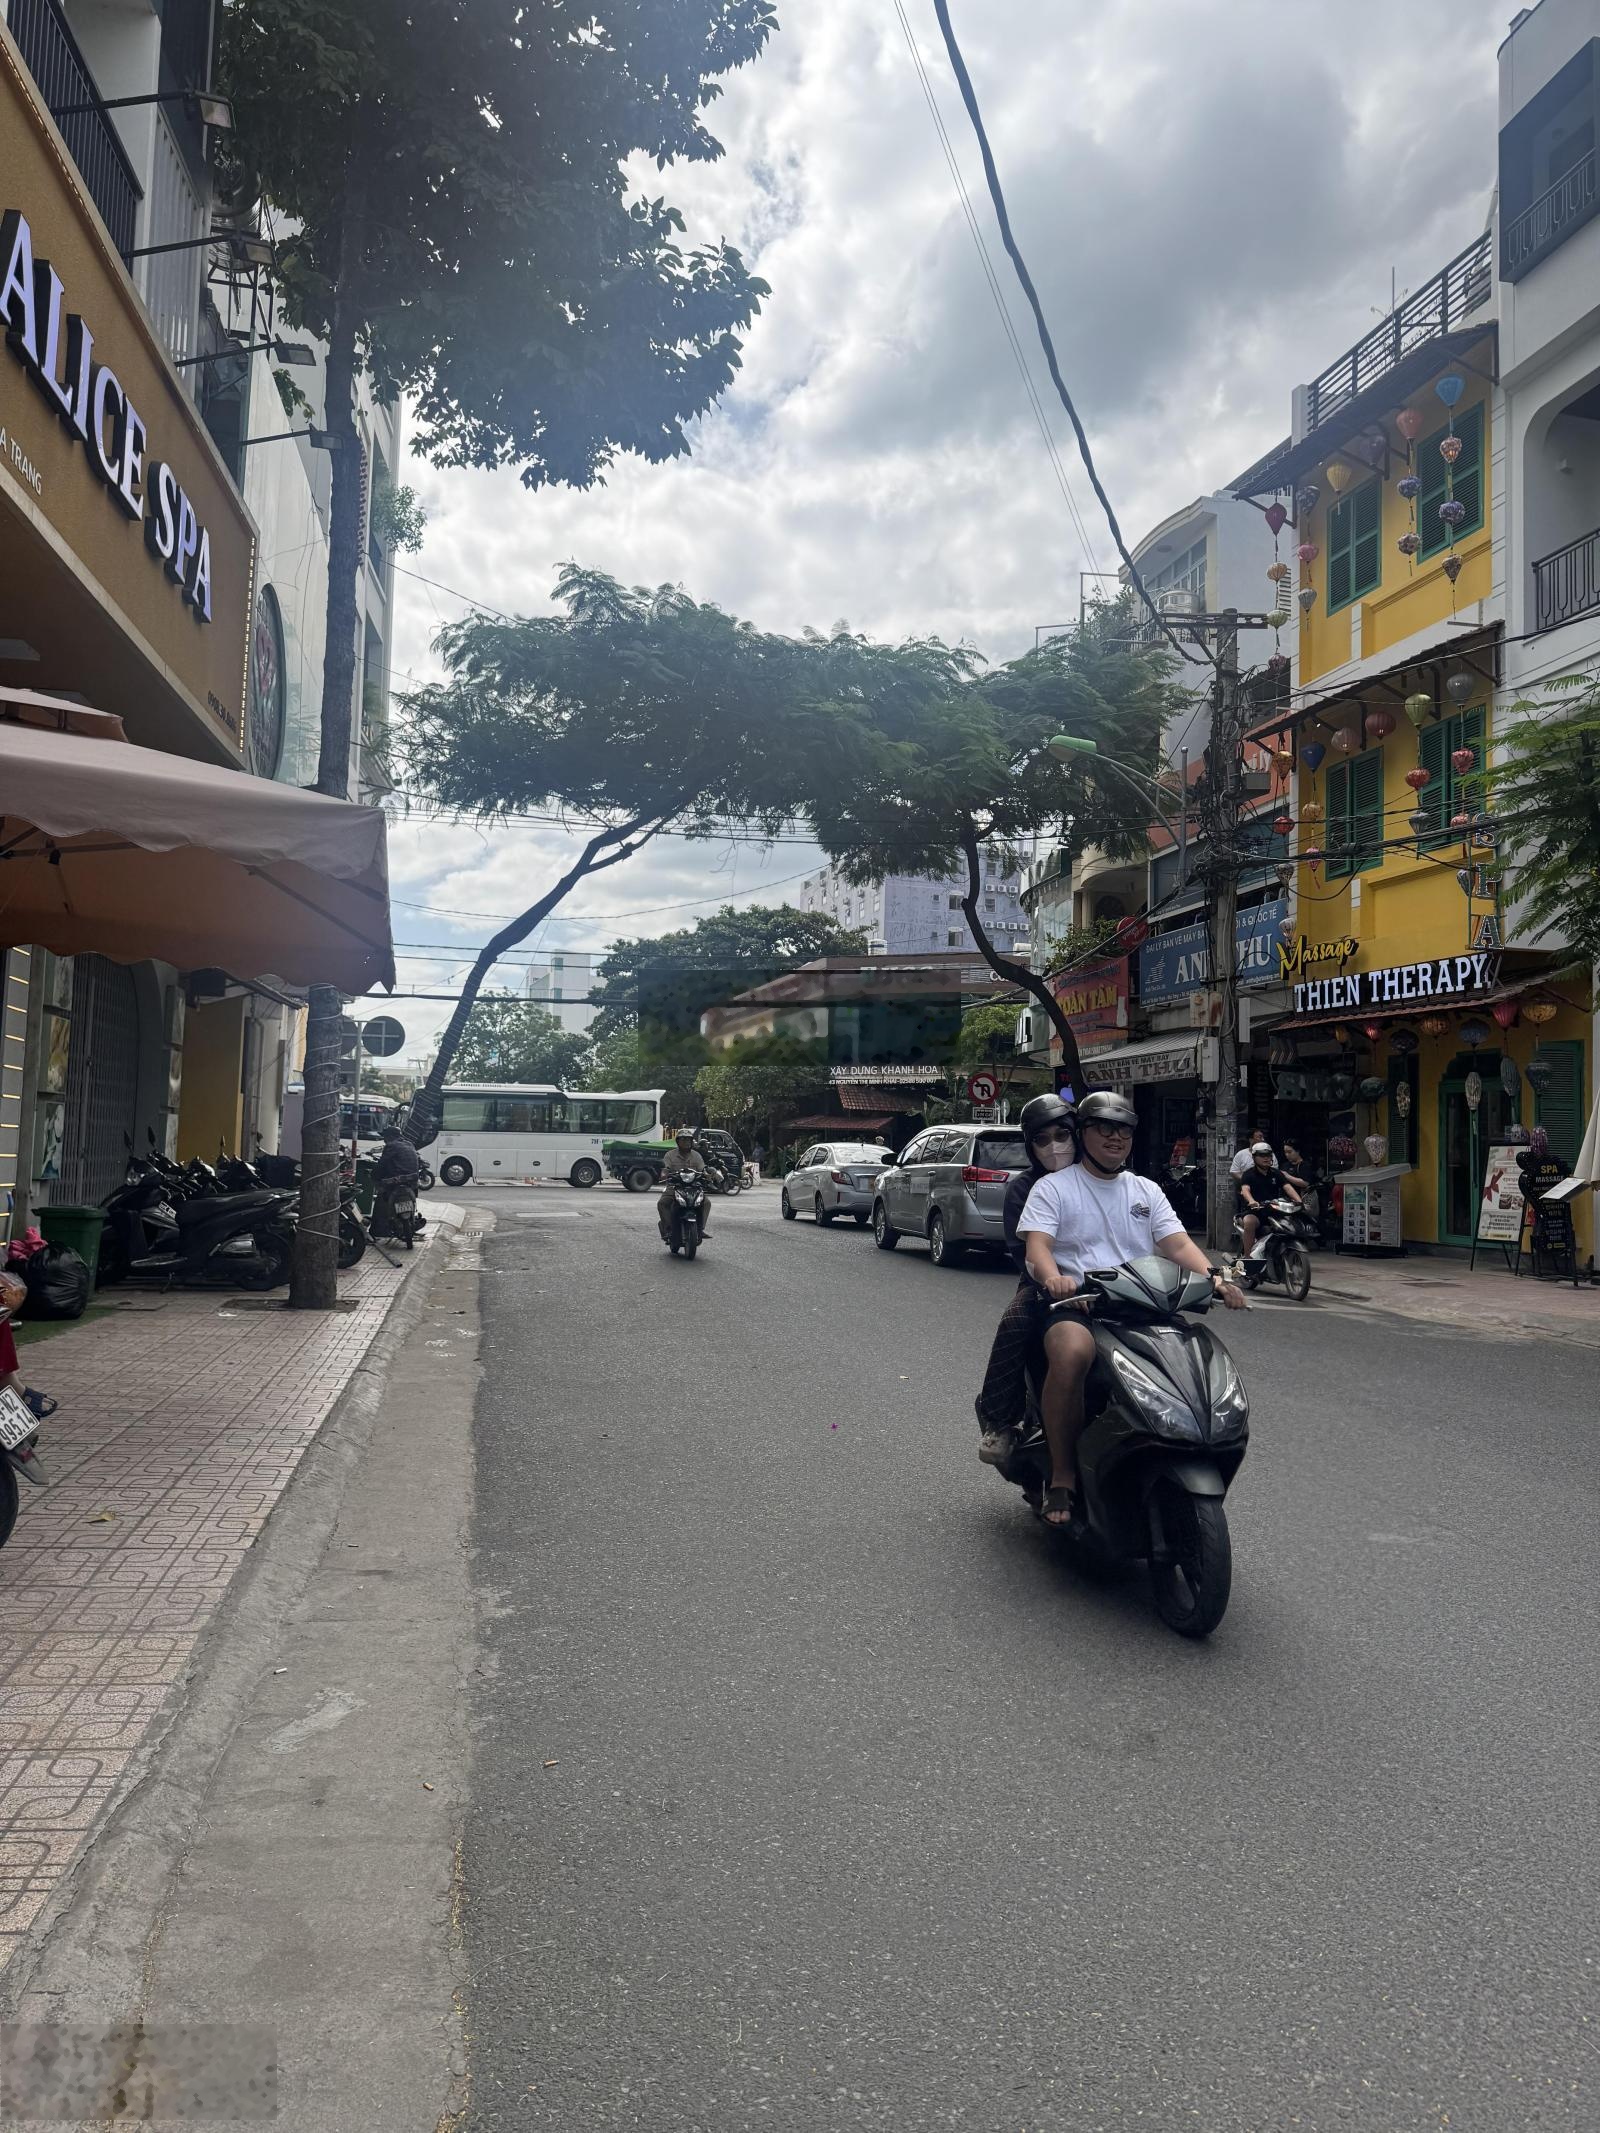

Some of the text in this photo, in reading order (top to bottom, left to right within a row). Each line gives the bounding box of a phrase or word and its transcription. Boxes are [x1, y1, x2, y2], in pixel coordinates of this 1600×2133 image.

[0, 213, 212, 623] ALICE SPA
[10, 437, 42, 496] TRANG
[1175, 950, 1208, 985] AN
[1277, 935, 1356, 980] Massage
[1294, 953, 1489, 1013] THIEN THERAPY
[1087, 1067, 1132, 1082] ANH
[1541, 1164, 1558, 1174] SPA
